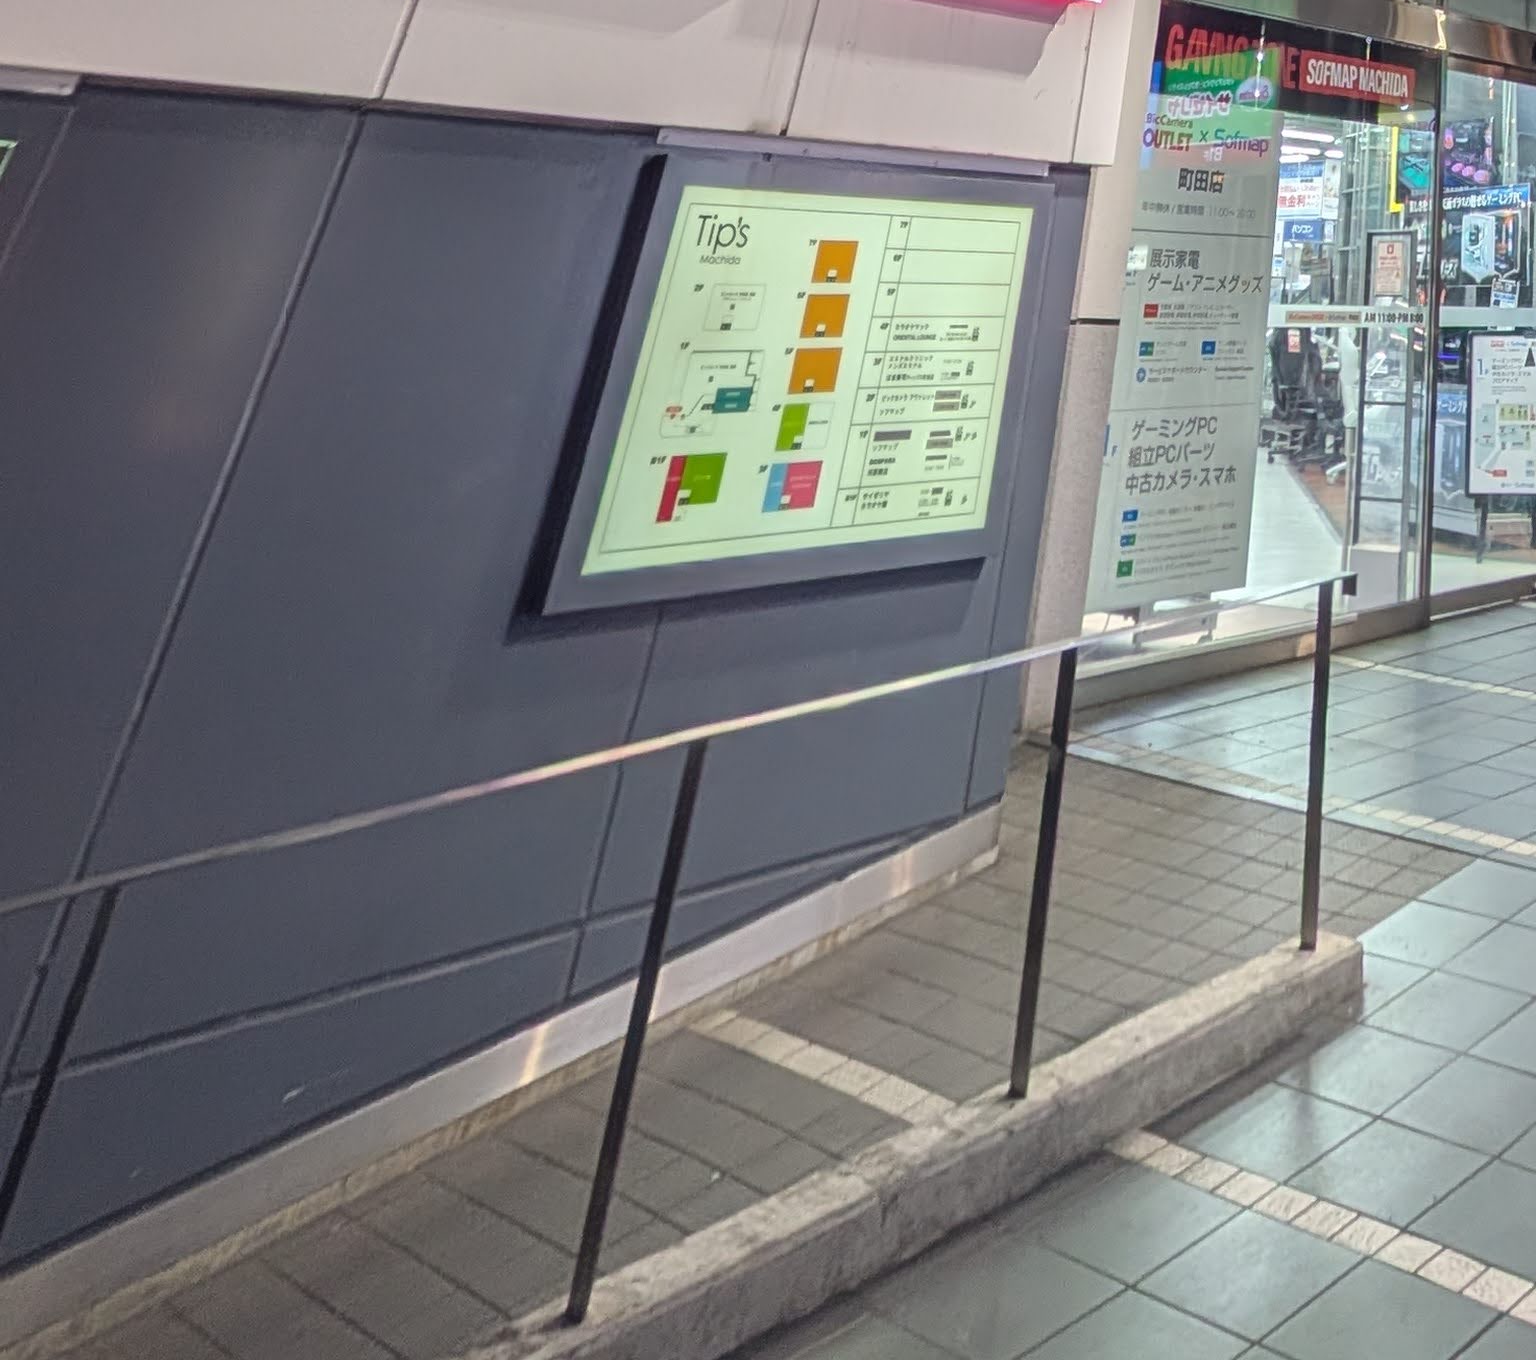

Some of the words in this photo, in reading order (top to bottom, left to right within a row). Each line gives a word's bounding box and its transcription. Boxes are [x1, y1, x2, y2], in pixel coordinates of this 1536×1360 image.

[1306, 58, 1357, 88] SOFMAP
[1143, 128, 1193, 151] OUTLET
[1213, 129, 1269, 157] Sofmap
[1178, 168, 1224, 193] 町田店
[697, 214, 751, 255] Tip's
[1150, 248, 1200, 269] 展示家電
[1148, 272, 1264, 294] ゲーム・アニメグッズ
[1132, 416, 1218, 440] ゲーミングPC
[1128, 442, 1215, 467] 組立PCパーツ
[1126, 465, 1237, 495] 中古カメラ・スマホ
